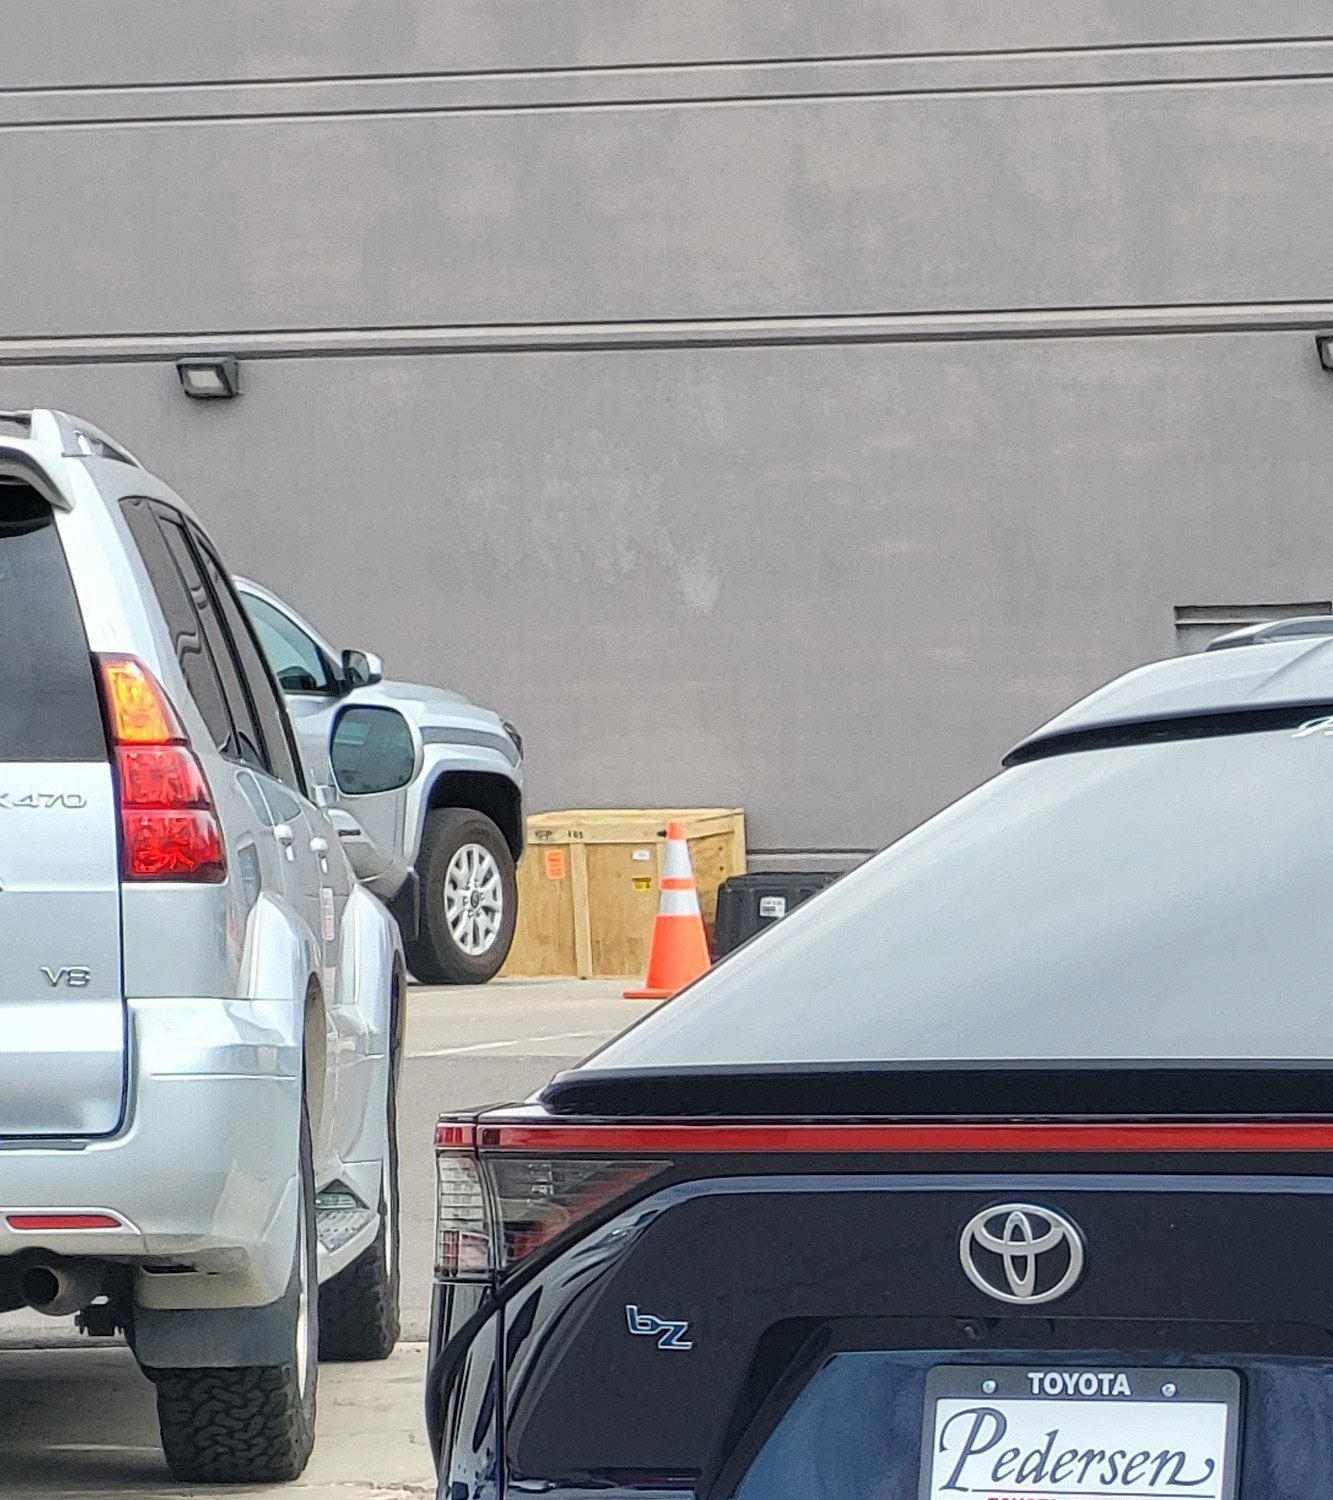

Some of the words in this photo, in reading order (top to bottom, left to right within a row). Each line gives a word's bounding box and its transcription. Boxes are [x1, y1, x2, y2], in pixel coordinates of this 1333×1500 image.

[40, 966, 91, 988] V8
[1028, 1372, 1131, 1396] TOYOTA
[939, 1406, 1215, 1492] Pedersen
